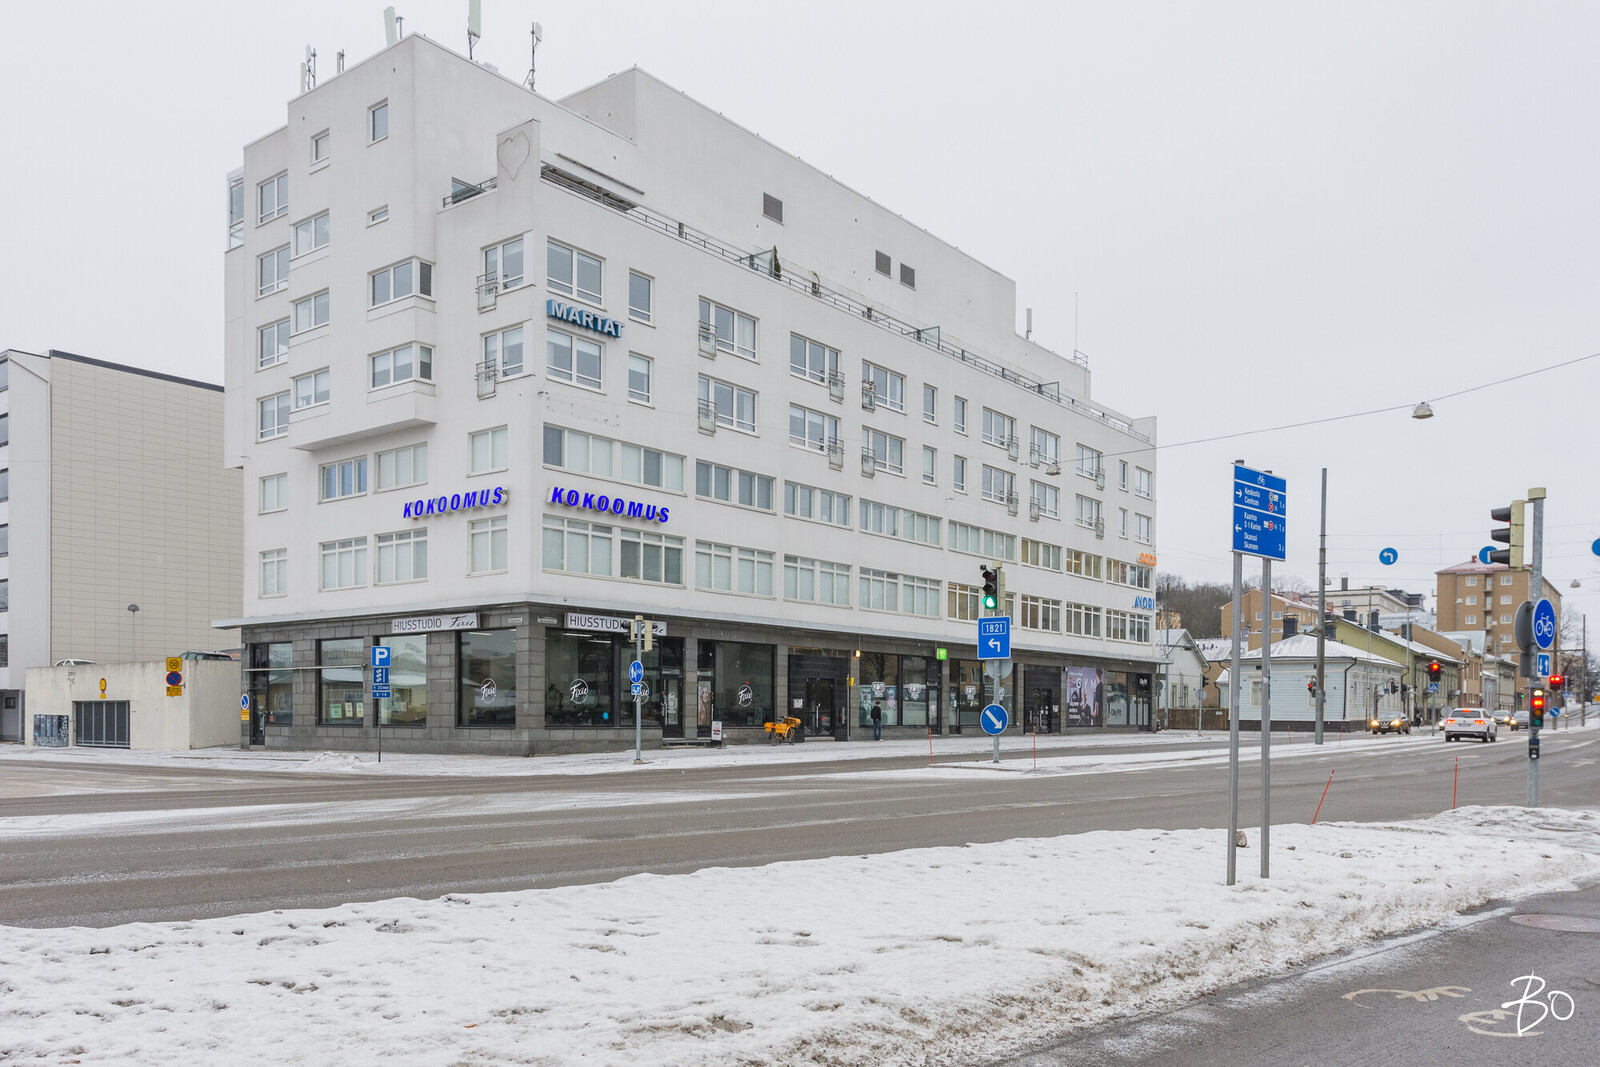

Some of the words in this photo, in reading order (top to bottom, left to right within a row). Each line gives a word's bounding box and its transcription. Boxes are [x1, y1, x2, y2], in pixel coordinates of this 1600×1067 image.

[547, 299, 625, 338] MARTAT
[403, 486, 503, 518] KOKOOMUS
[551, 486, 670, 523] KOKOOMUS
[1134, 595, 1155, 610] AVORI
[393, 617, 442, 631] HIUSSTUDIO
[450, 614, 475, 628] Fixie
[986, 624, 1003, 633] 1821
[375, 648, 388, 665] P
[570, 682, 588, 701] Fixie
